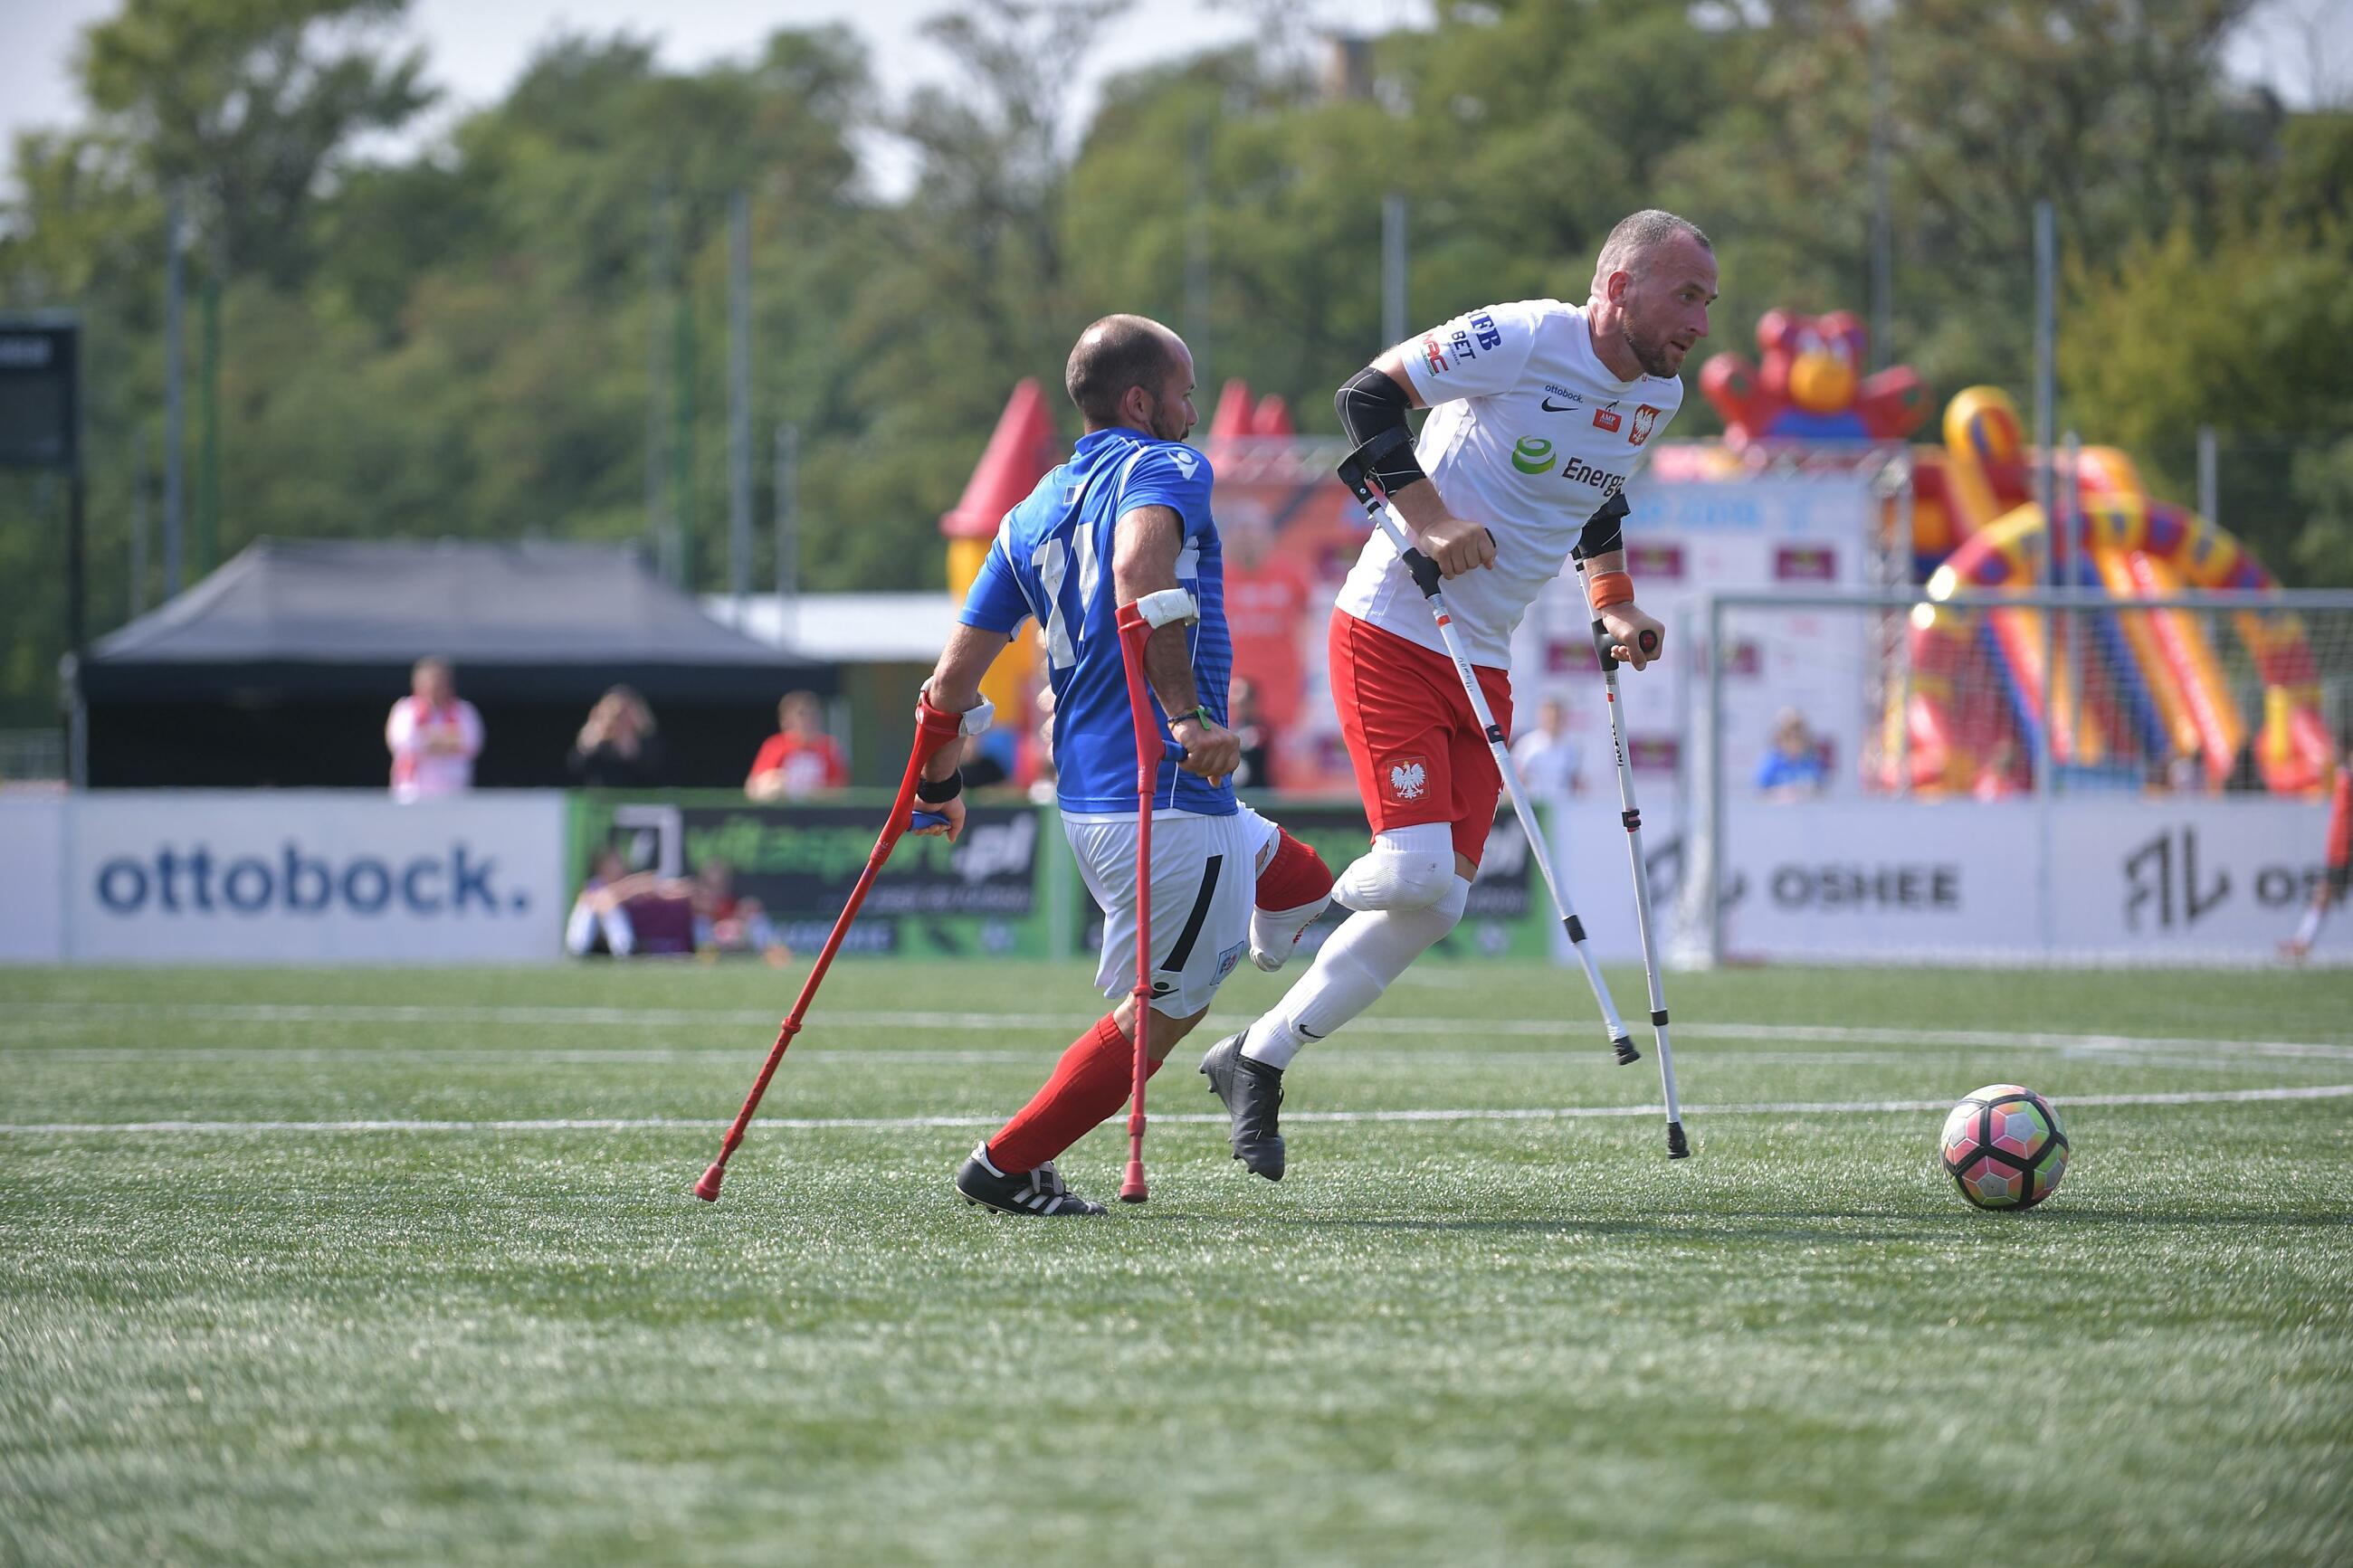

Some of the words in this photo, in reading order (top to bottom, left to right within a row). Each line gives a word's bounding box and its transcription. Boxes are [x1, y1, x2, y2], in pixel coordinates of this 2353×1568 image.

[1452, 330, 1476, 359] BET
[1545, 384, 1583, 404] ottobock.
[97, 845, 530, 914] ottobock.
[1773, 864, 1958, 908] OSHEE
